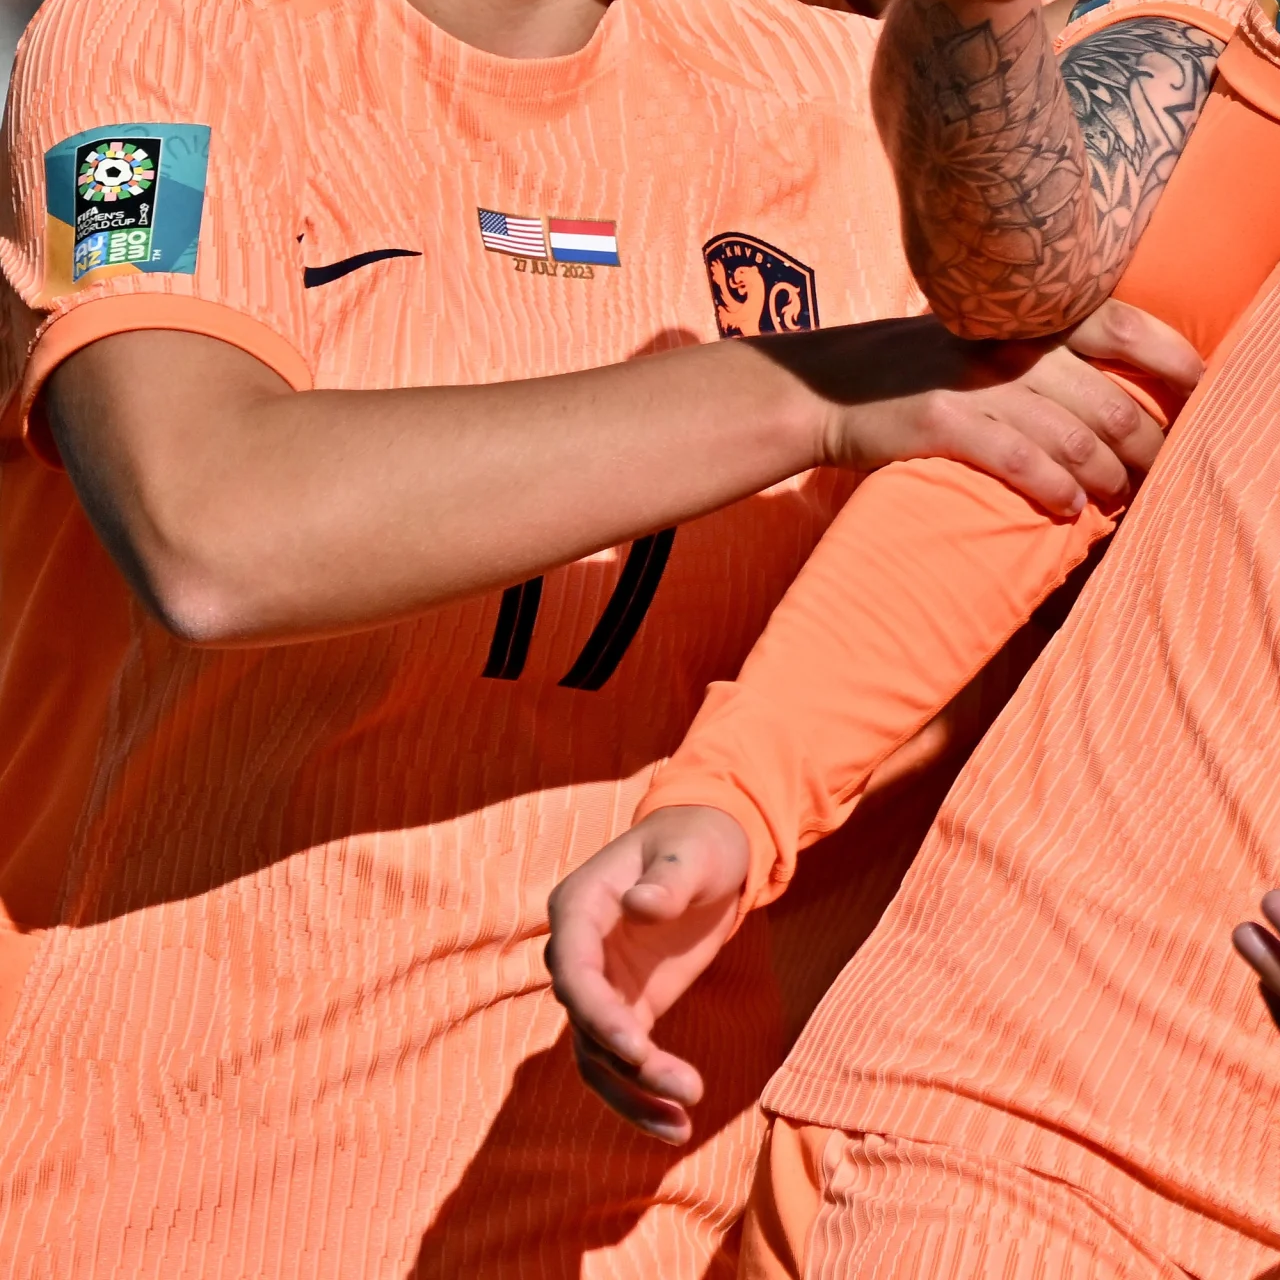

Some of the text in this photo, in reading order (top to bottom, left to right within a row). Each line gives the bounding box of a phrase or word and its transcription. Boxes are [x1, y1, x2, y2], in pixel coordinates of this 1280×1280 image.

[77, 206, 99, 224] FIFA
[77, 211, 125, 232] WOMEN'S
[77, 218, 135, 240] WORLD CUP
[111, 231, 147, 248] 20
[76, 236, 104, 262] AU
[109, 245, 144, 262] 23
[726, 245, 763, 264] KNVB
[76, 251, 102, 277] NZ
[512, 258, 595, 280] 27 JULY 2023
